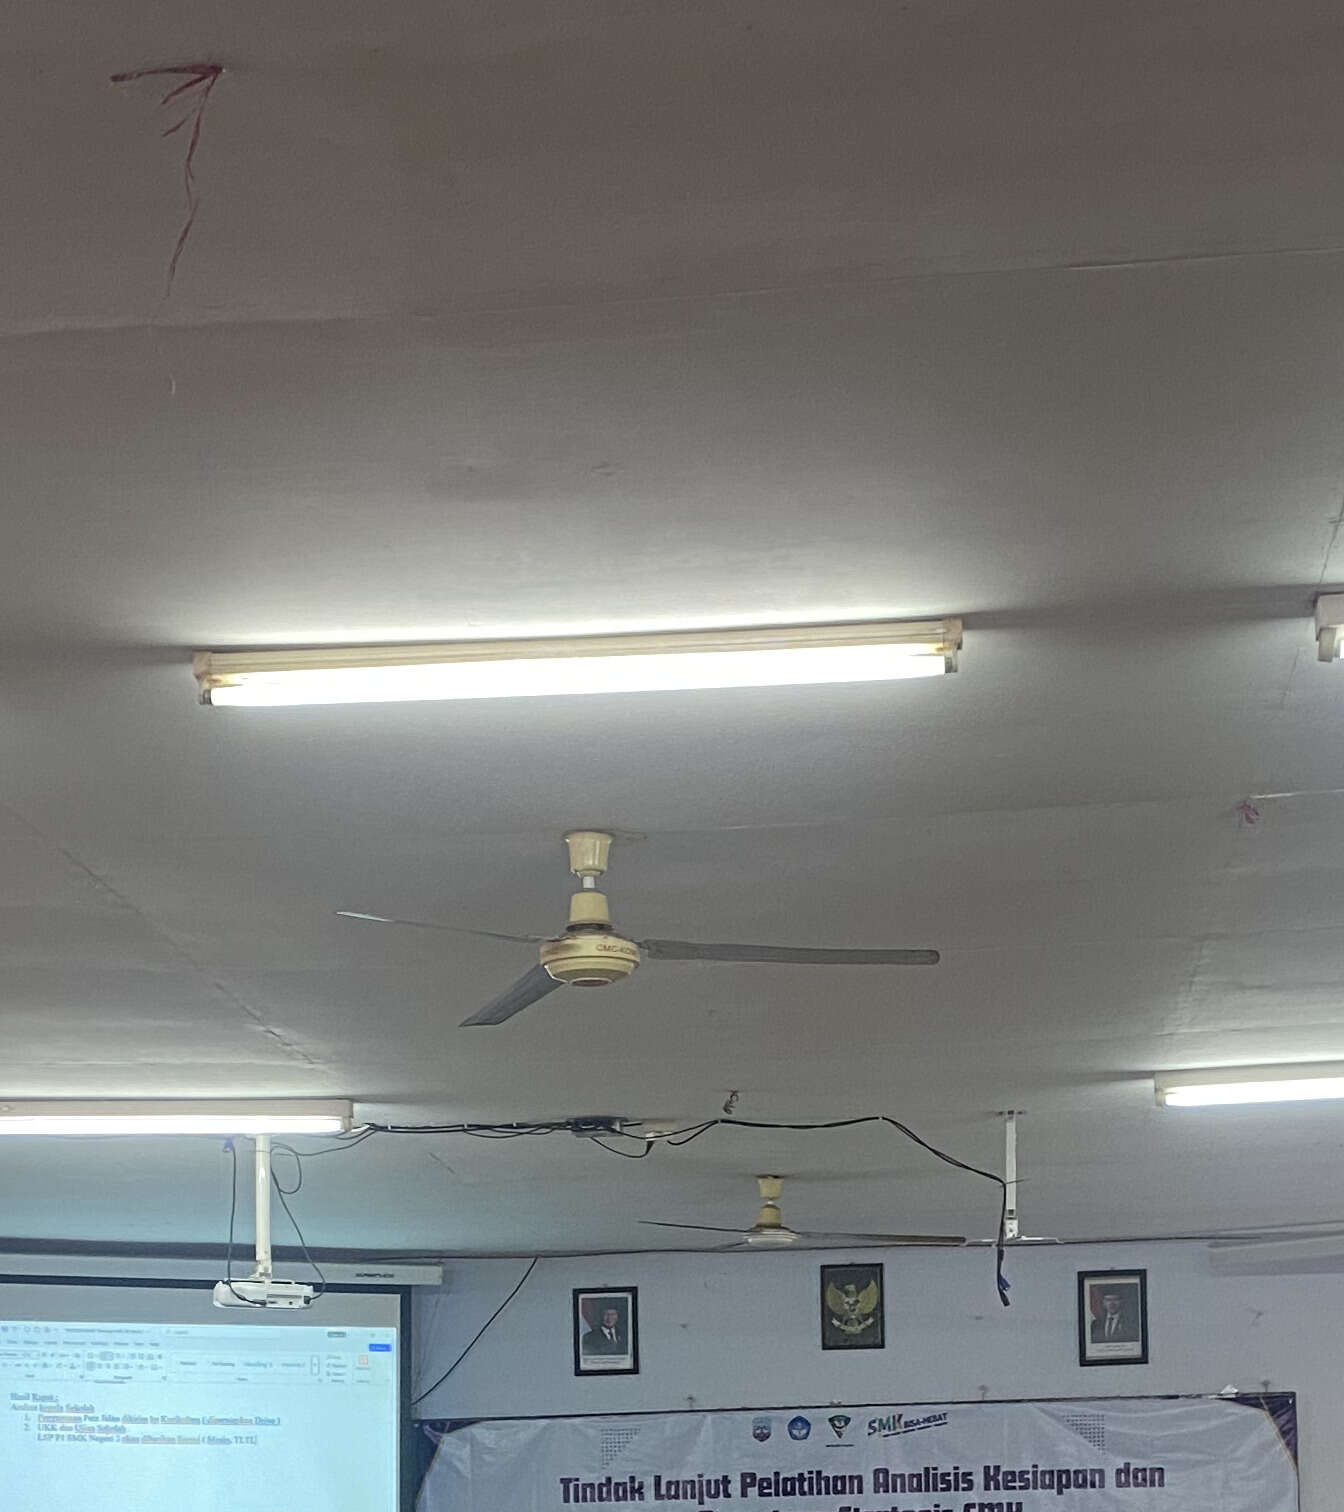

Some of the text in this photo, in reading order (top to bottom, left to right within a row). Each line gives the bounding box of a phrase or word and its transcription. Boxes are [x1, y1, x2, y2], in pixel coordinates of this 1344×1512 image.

[867, 1413, 904, 1436] SMK
[559, 1461, 1166, 1506] Tindak Lanjut Pelatihan Analisis Kesiapan dan
